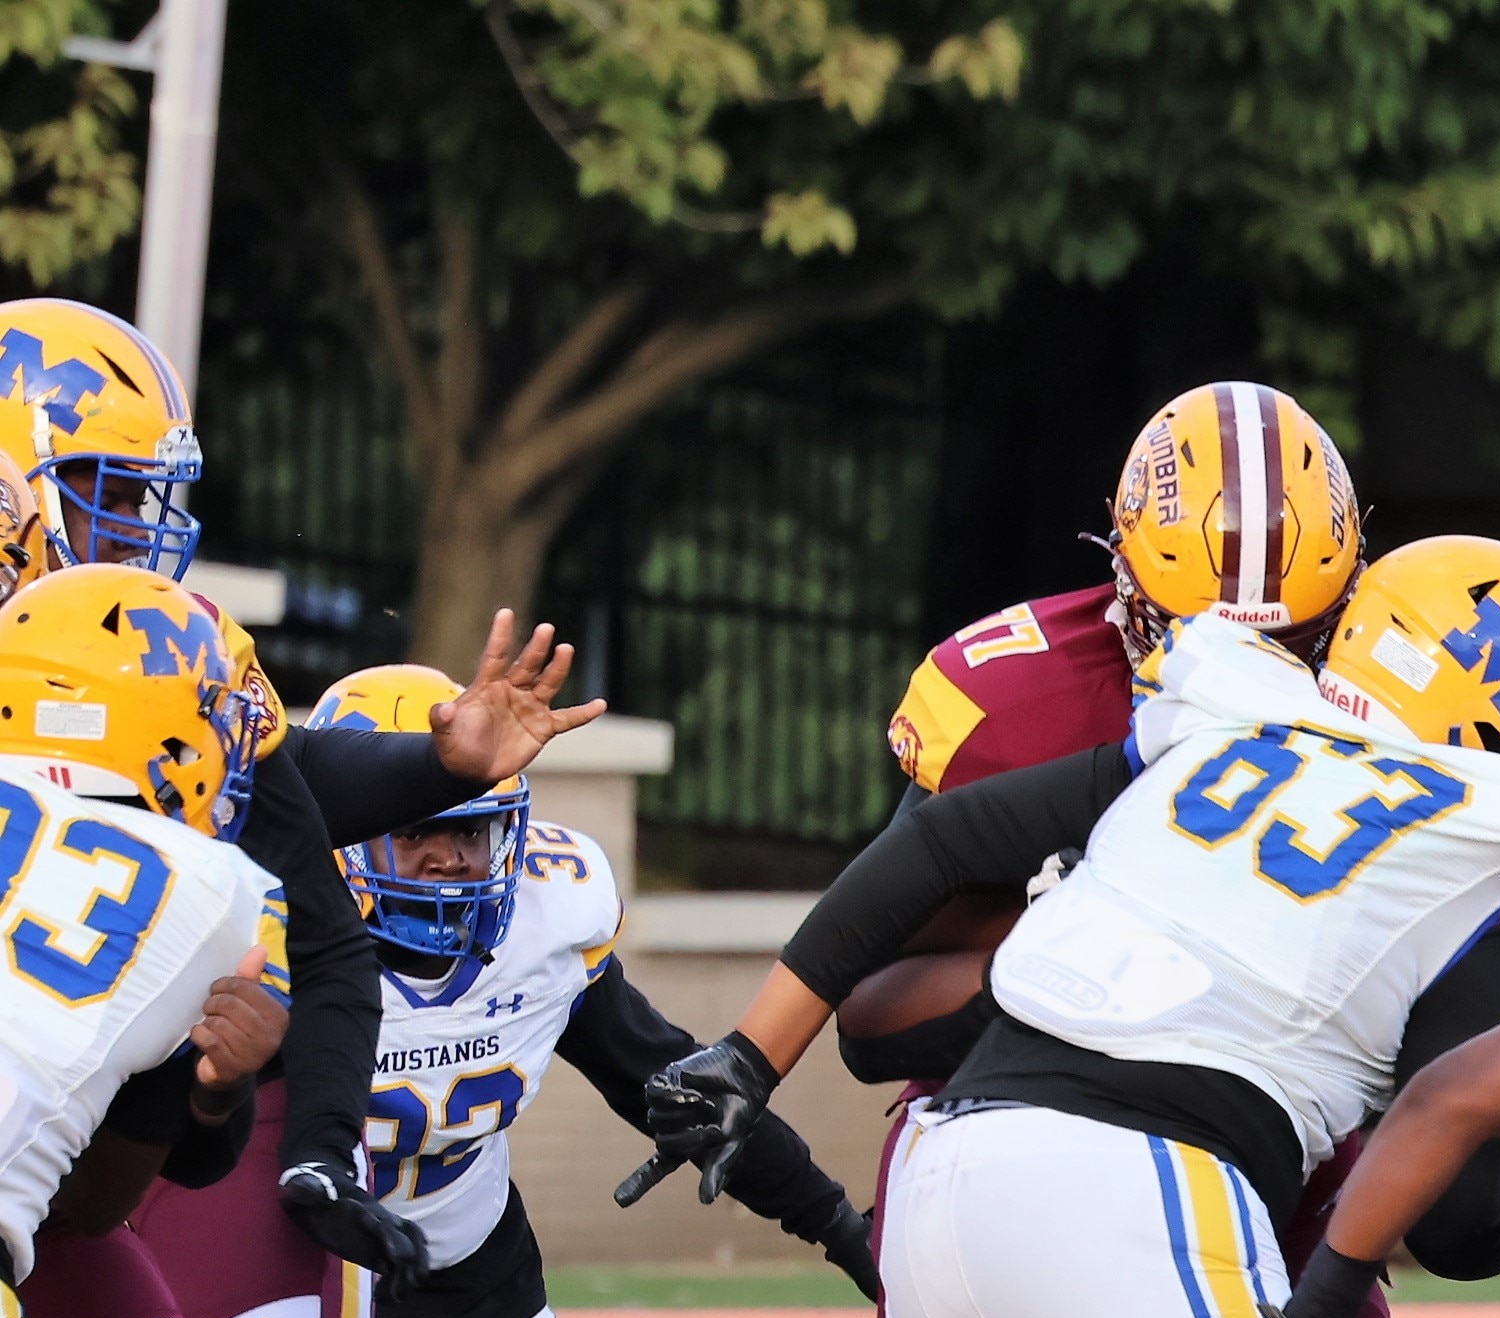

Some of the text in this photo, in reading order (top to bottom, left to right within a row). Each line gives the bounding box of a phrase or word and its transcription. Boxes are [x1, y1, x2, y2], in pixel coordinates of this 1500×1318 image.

[0, 327, 108, 436] M
[125, 607, 229, 684] M
[372, 1035, 501, 1074] MUSTANGS
